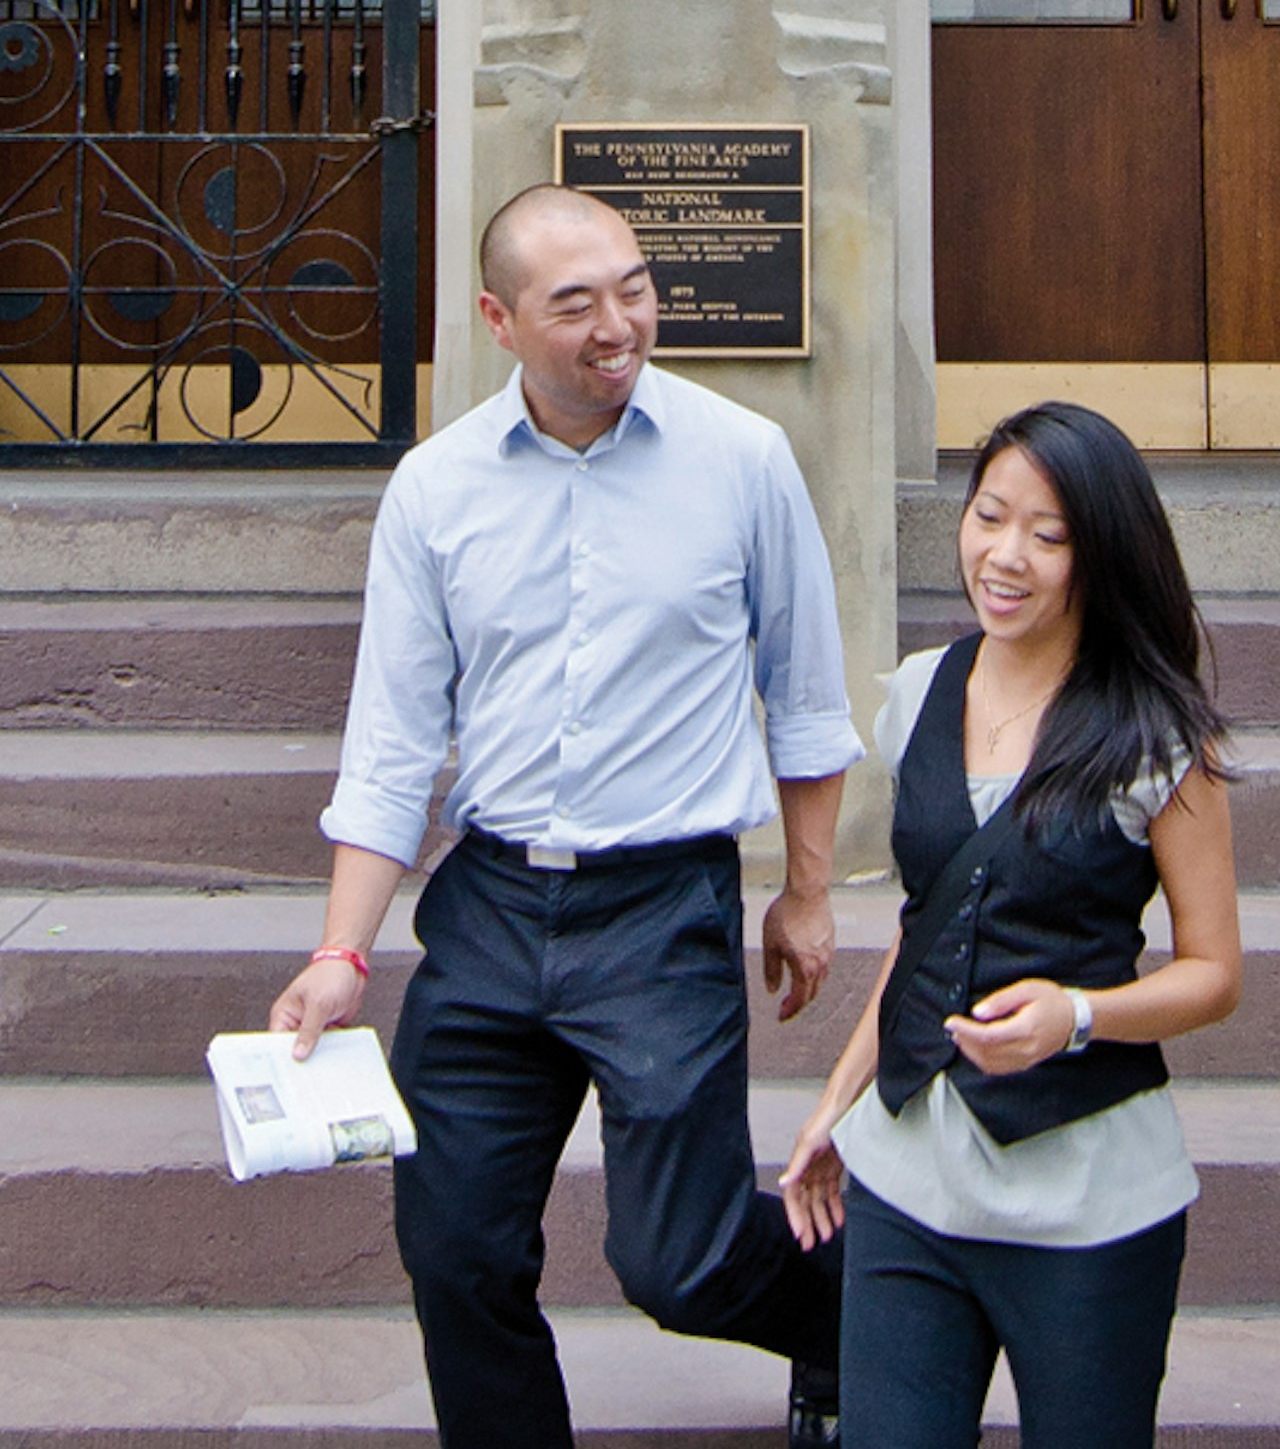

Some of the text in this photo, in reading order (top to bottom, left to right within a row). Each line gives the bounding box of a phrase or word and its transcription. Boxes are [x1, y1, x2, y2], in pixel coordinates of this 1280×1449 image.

[574, 142, 792, 157] THE PENNSYLVANIA ACADEMY
[617, 155, 749, 168] OF THE FINE ARTS
[642, 192, 723, 206] NATIONAL
[677, 208, 767, 223] LANDMARK
